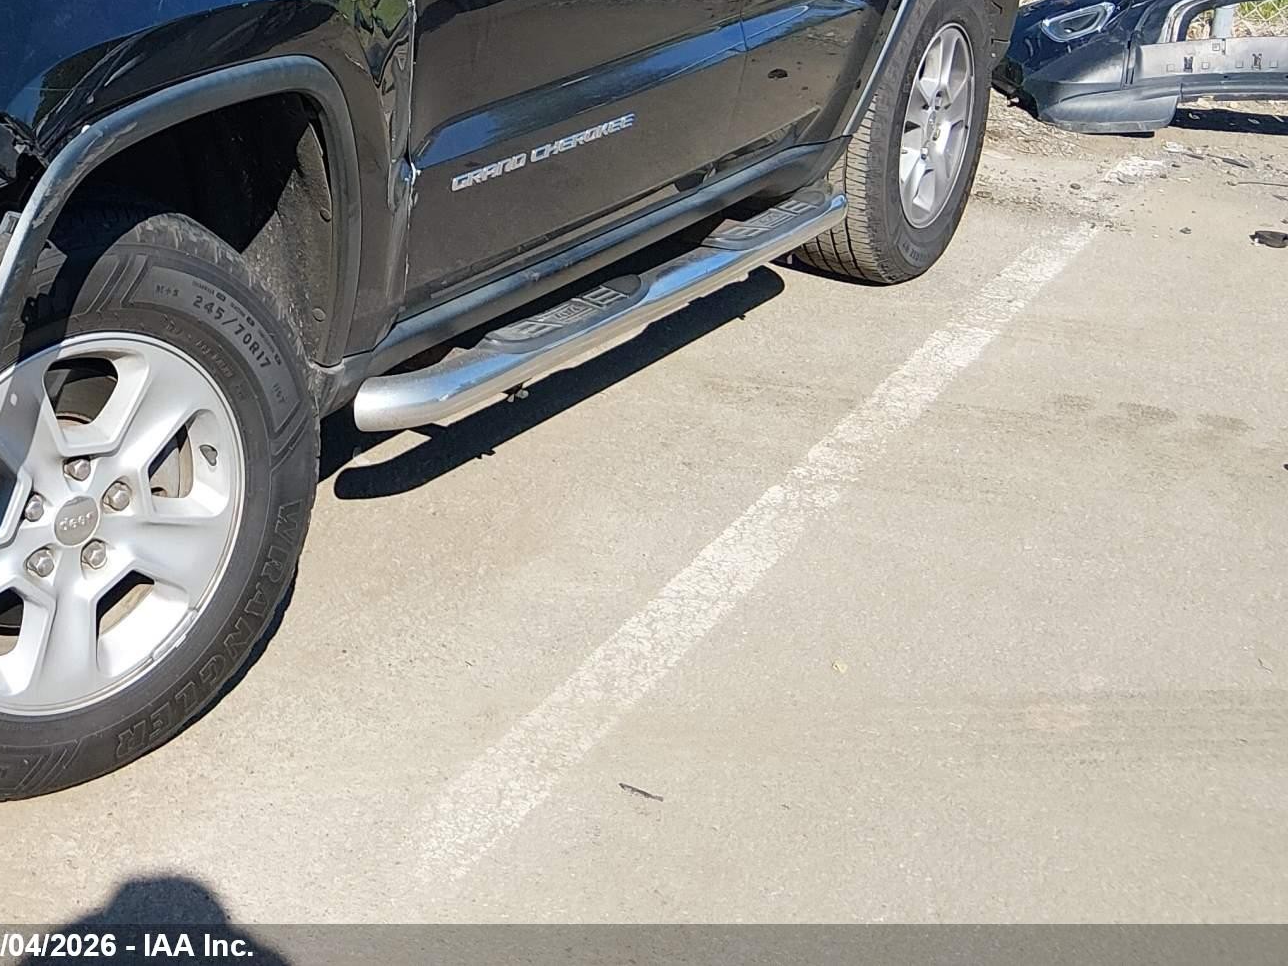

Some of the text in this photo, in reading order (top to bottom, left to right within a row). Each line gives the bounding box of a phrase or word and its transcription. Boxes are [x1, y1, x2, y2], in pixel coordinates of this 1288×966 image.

[451, 113, 636, 192] GRAND CHEROKEE
[192, 294, 272, 368] 245/70R17
[116, 497, 305, 758] WRANGLER
